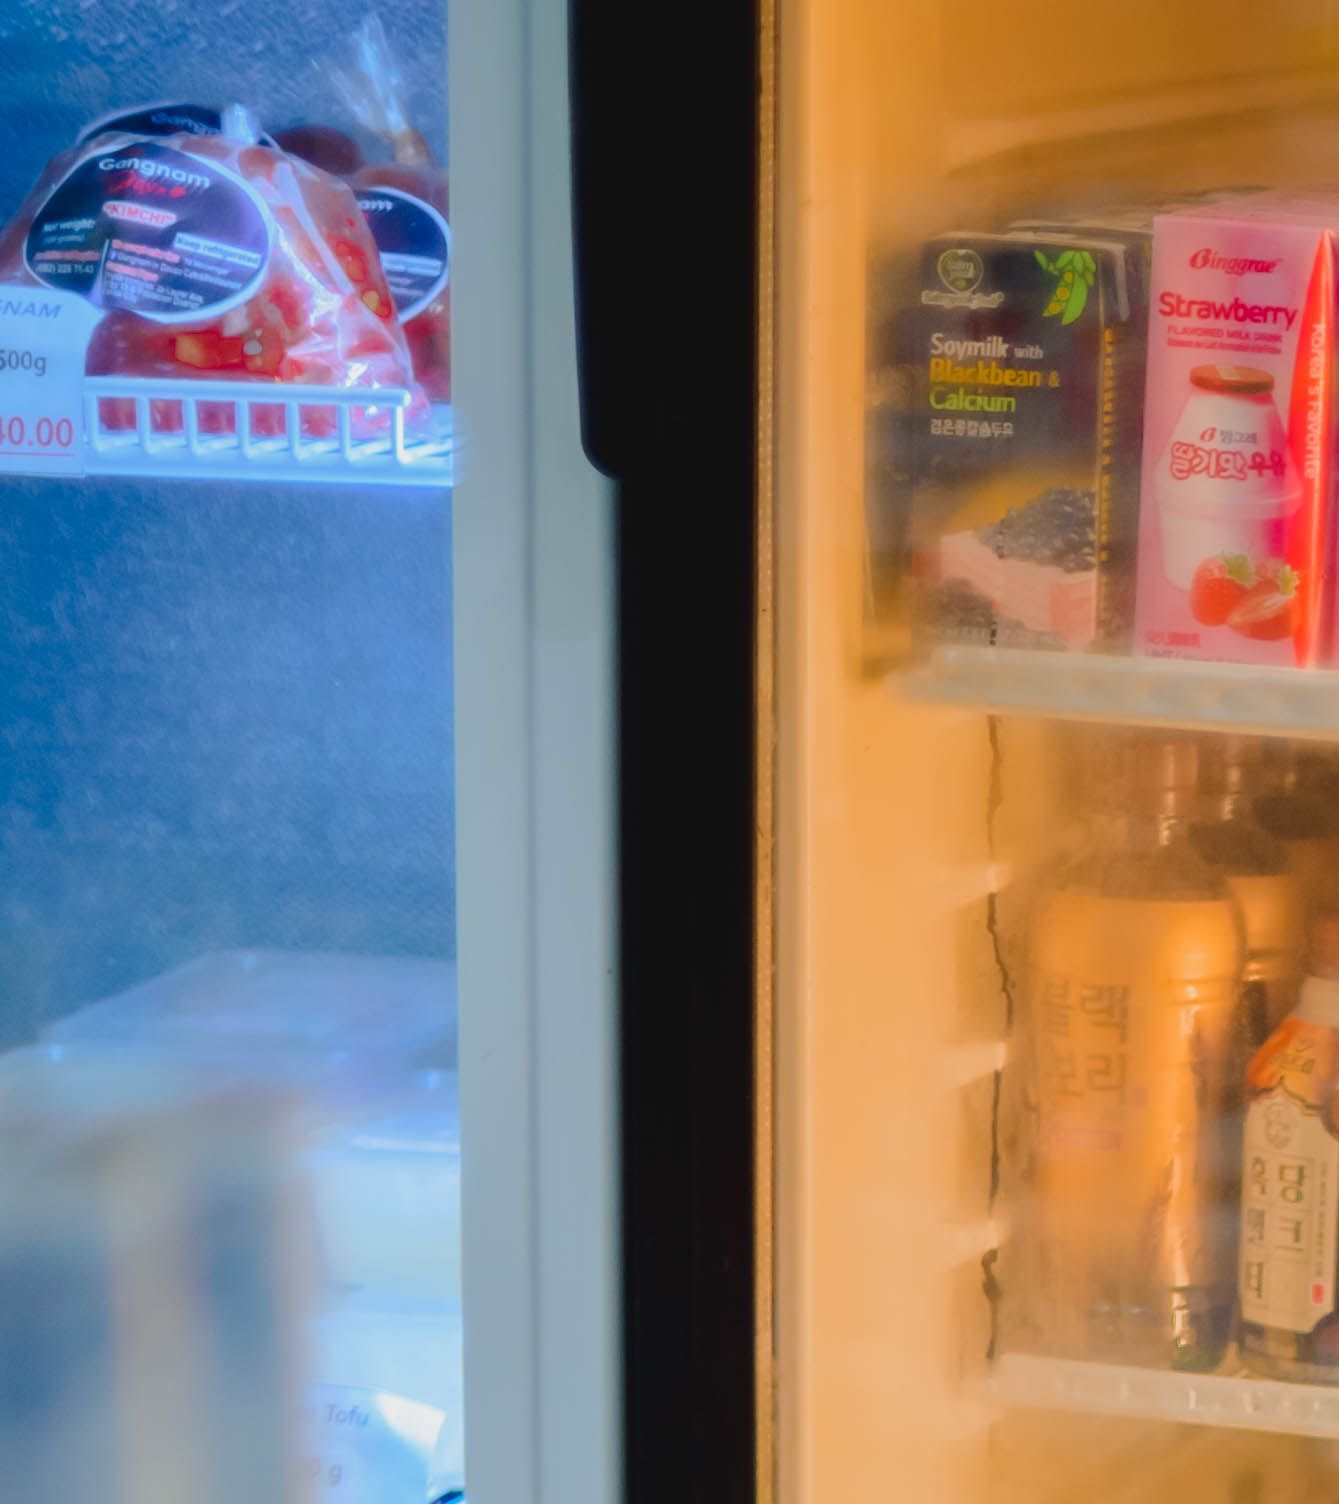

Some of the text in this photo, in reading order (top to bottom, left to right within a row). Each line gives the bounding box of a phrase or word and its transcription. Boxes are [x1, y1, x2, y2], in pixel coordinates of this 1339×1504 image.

[99, 157, 210, 188] Gangnam
[1158, 291, 1298, 331] Strawberry
[931, 333, 1044, 360] Soymilk with
[930, 357, 1041, 387] Blackbean
[929, 387, 1017, 412] Calcium
[326, 1403, 369, 1427] Tofu
